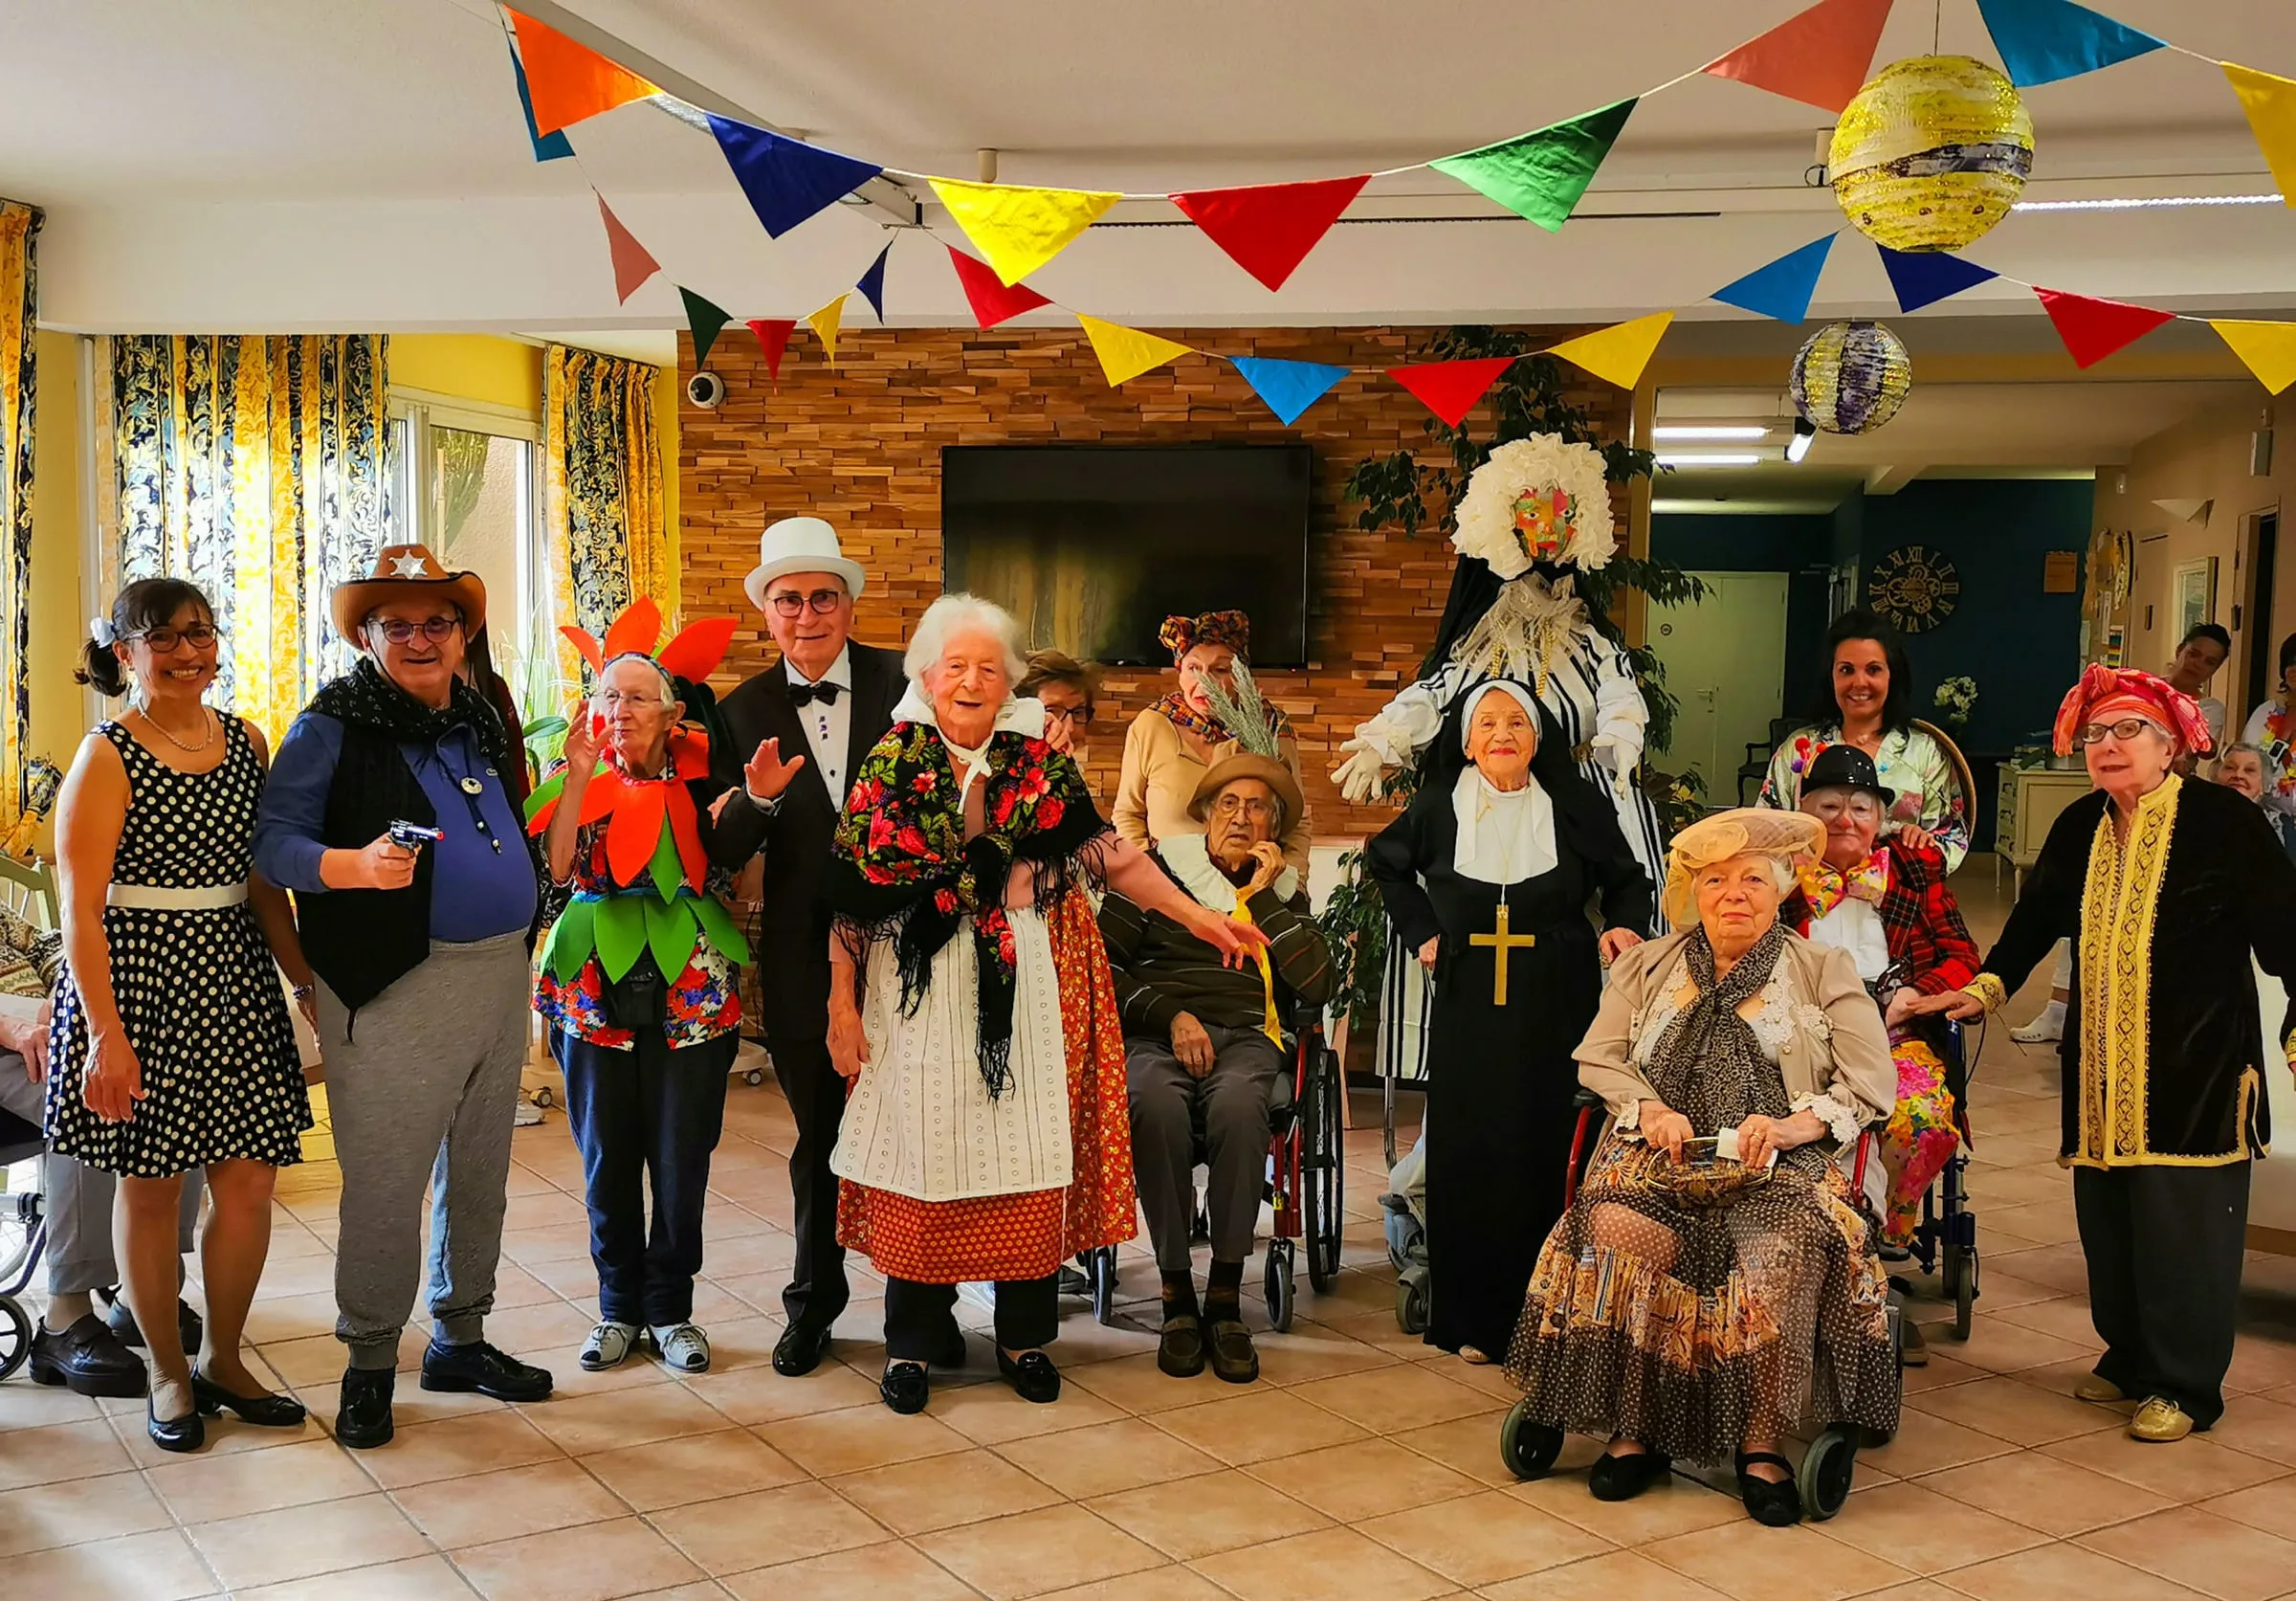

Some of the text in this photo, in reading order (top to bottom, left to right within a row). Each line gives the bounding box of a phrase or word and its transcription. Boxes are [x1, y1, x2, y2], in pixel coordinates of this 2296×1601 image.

[1906, 545, 1924, 564] XII
[1927, 551, 1941, 567] I
[1873, 565, 1893, 580] X
[1936, 562, 1956, 580] II
[1942, 582, 1959, 594] III
[1906, 615, 1921, 633] VI
[1926, 612, 1940, 630] V
